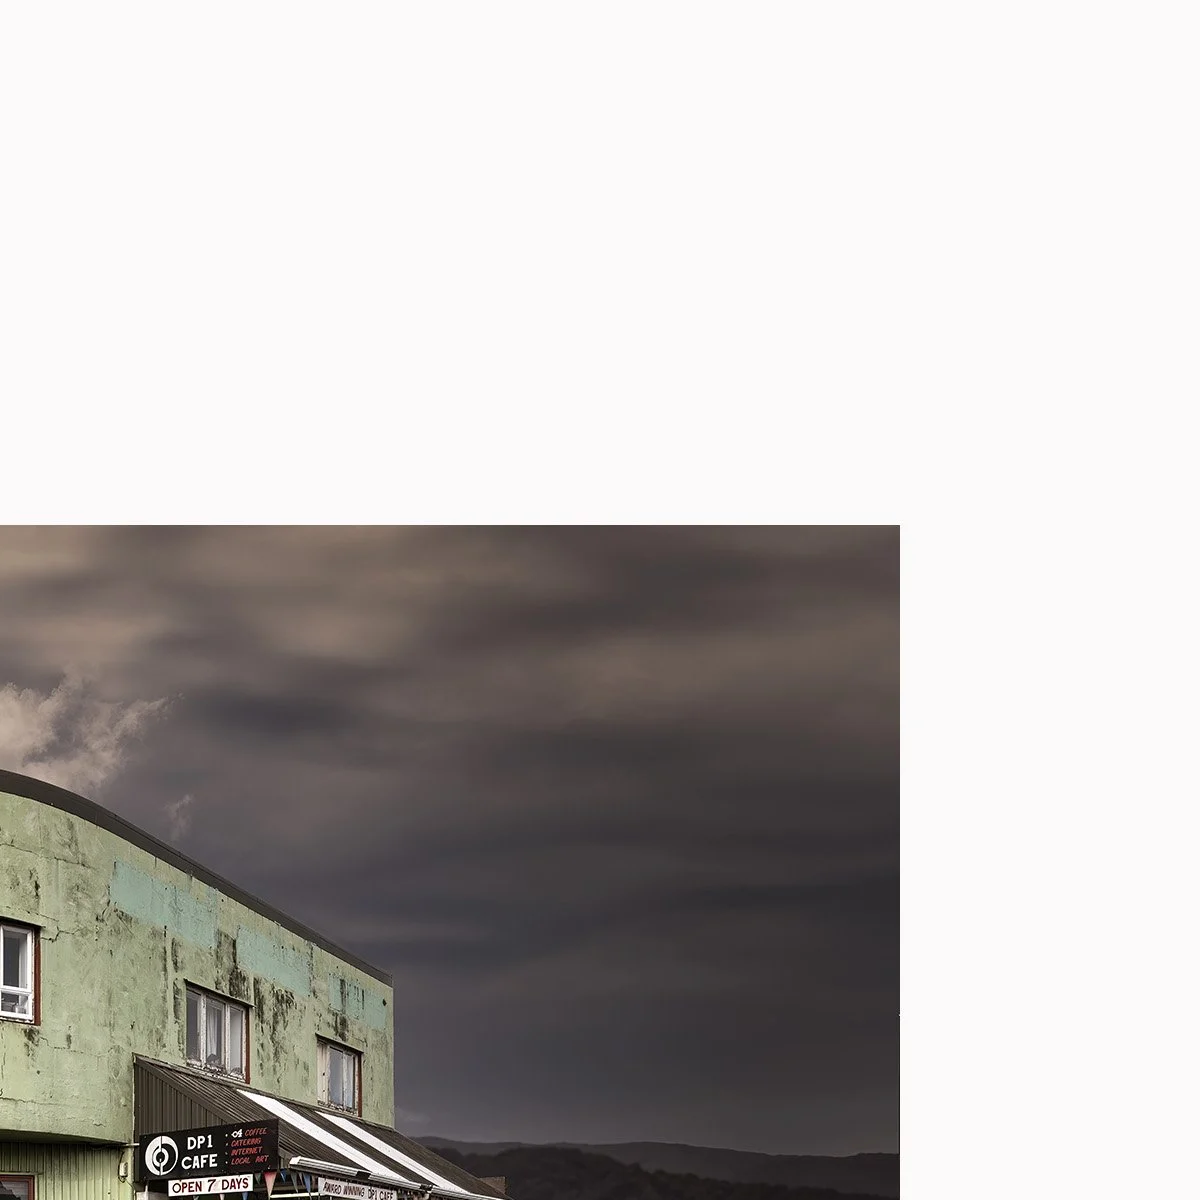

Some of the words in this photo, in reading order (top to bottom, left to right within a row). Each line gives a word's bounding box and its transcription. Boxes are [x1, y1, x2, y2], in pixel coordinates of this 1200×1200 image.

[244, 1127, 268, 1137] COFFEE
[187, 1134, 213, 1150] DP1
[231, 1138, 261, 1147] CATERING
[231, 1146, 262, 1156] INTERNET
[181, 1153, 218, 1170] CAFE
[231, 1157, 251, 1166] LOCAL
[255, 1155, 269, 1164] ART
[172, 1181, 202, 1193] OPEN
[207, 1179, 216, 1192] 7
[221, 1177, 249, 1190] DAYS
[322, 1181, 341, 1194] AWARD
[343, 1185, 365, 1197] WINNING
